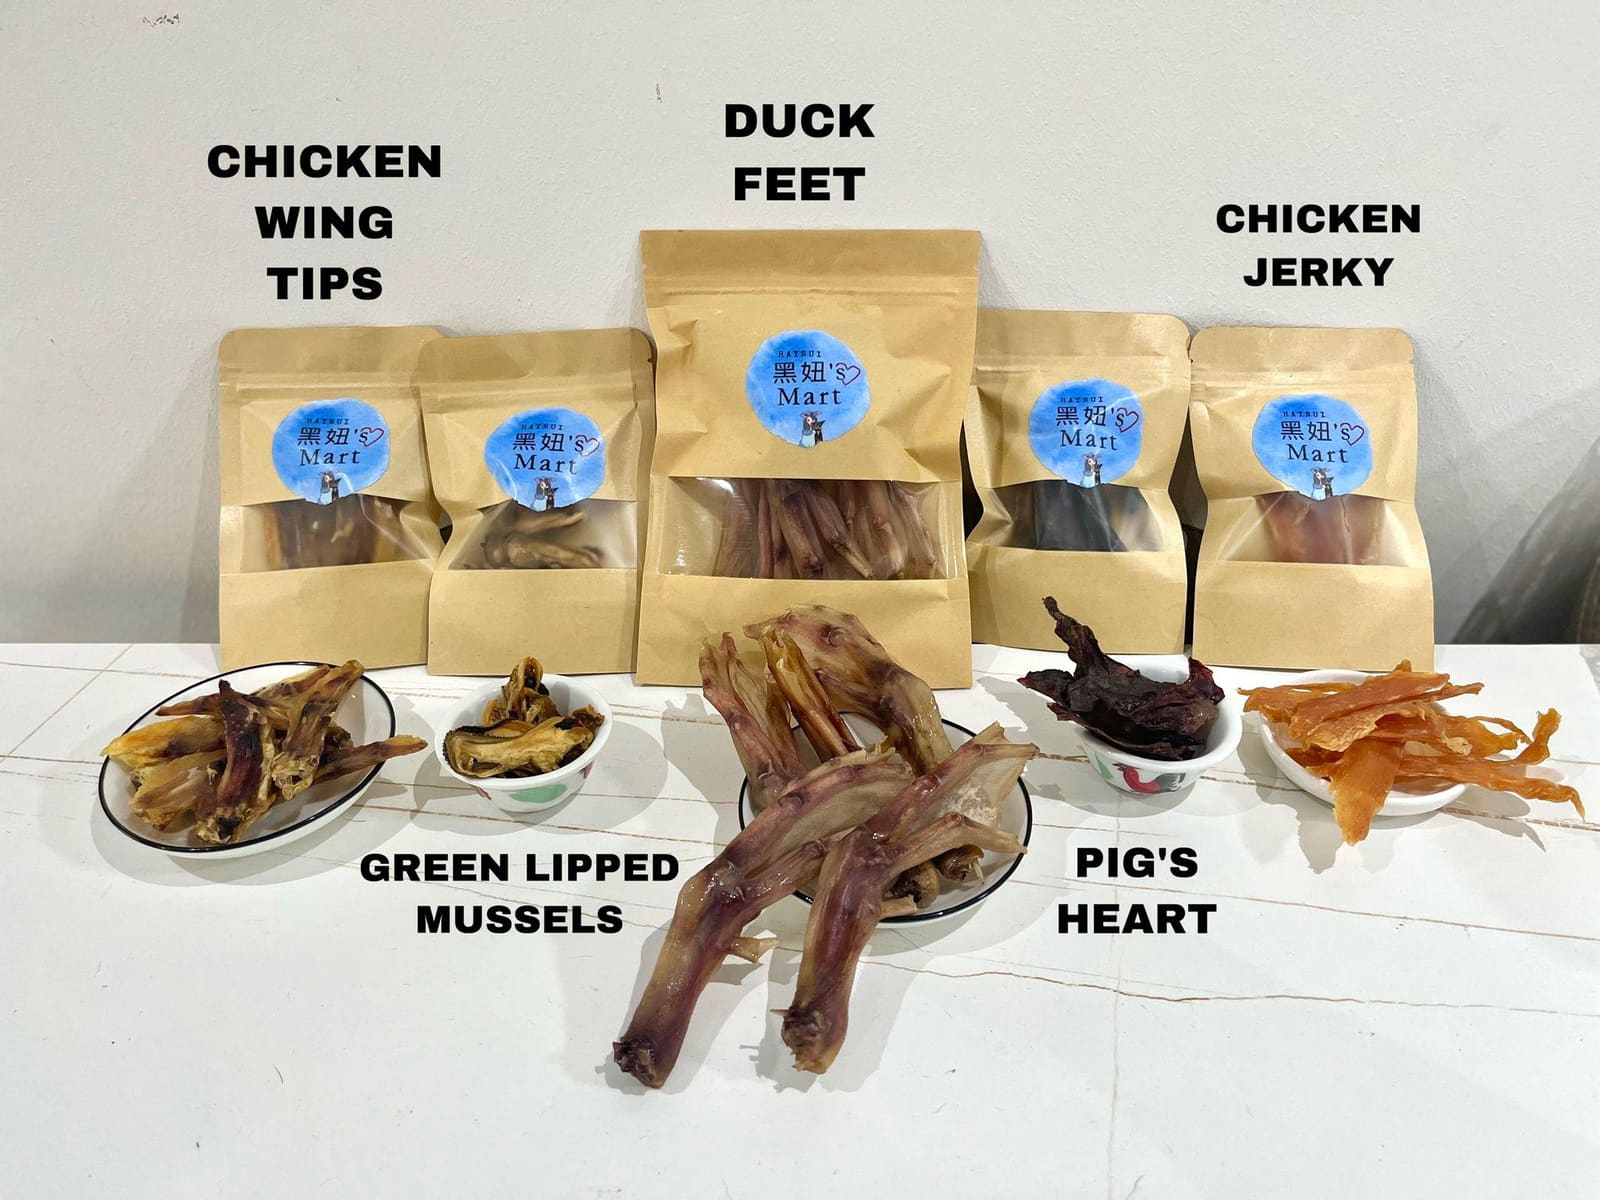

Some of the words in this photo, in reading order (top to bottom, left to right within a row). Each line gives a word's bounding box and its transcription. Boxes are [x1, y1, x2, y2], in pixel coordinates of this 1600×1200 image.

[777, 387, 841, 406] Mart
[1059, 428, 1117, 451] Mart
[299, 448, 361, 467] Mart
[513, 453, 577, 475] Mart
[1286, 443, 1348, 464] Mart
